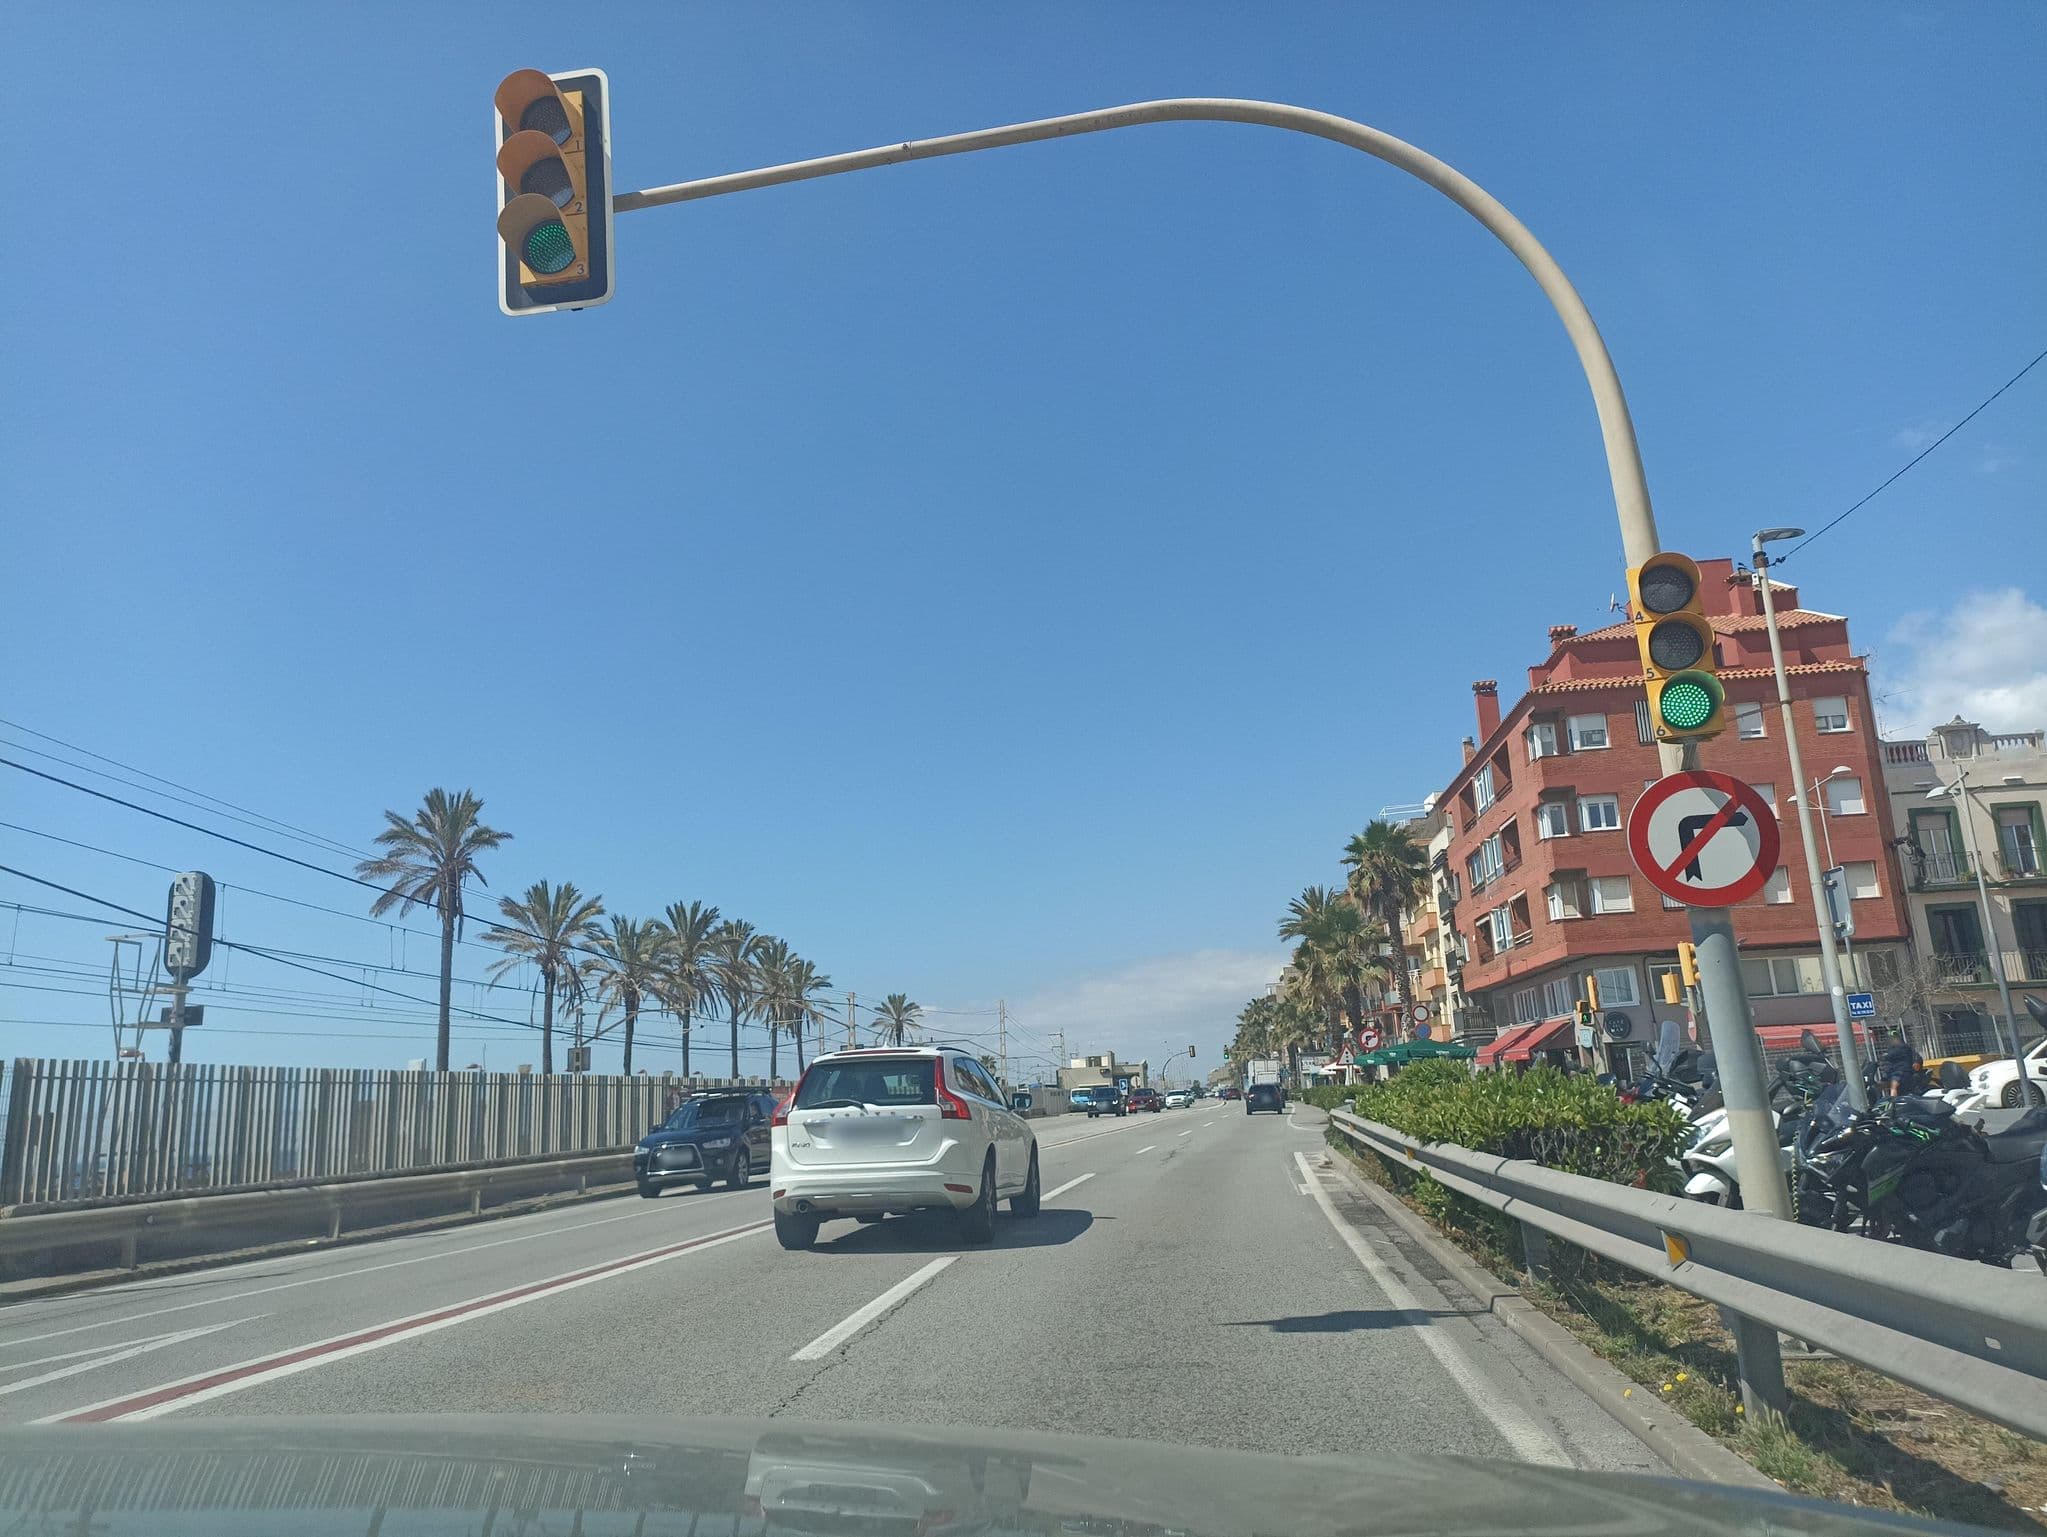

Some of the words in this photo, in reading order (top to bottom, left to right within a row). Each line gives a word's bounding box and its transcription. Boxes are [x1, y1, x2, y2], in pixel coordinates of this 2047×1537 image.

[575, 202, 584, 213] 2
[576, 263, 585, 275] 3
[1635, 611, 1644, 622] 4
[1646, 667, 1655, 679] 5
[1656, 725, 1666, 737] 6
[1850, 1001, 1872, 1010] TAXI
